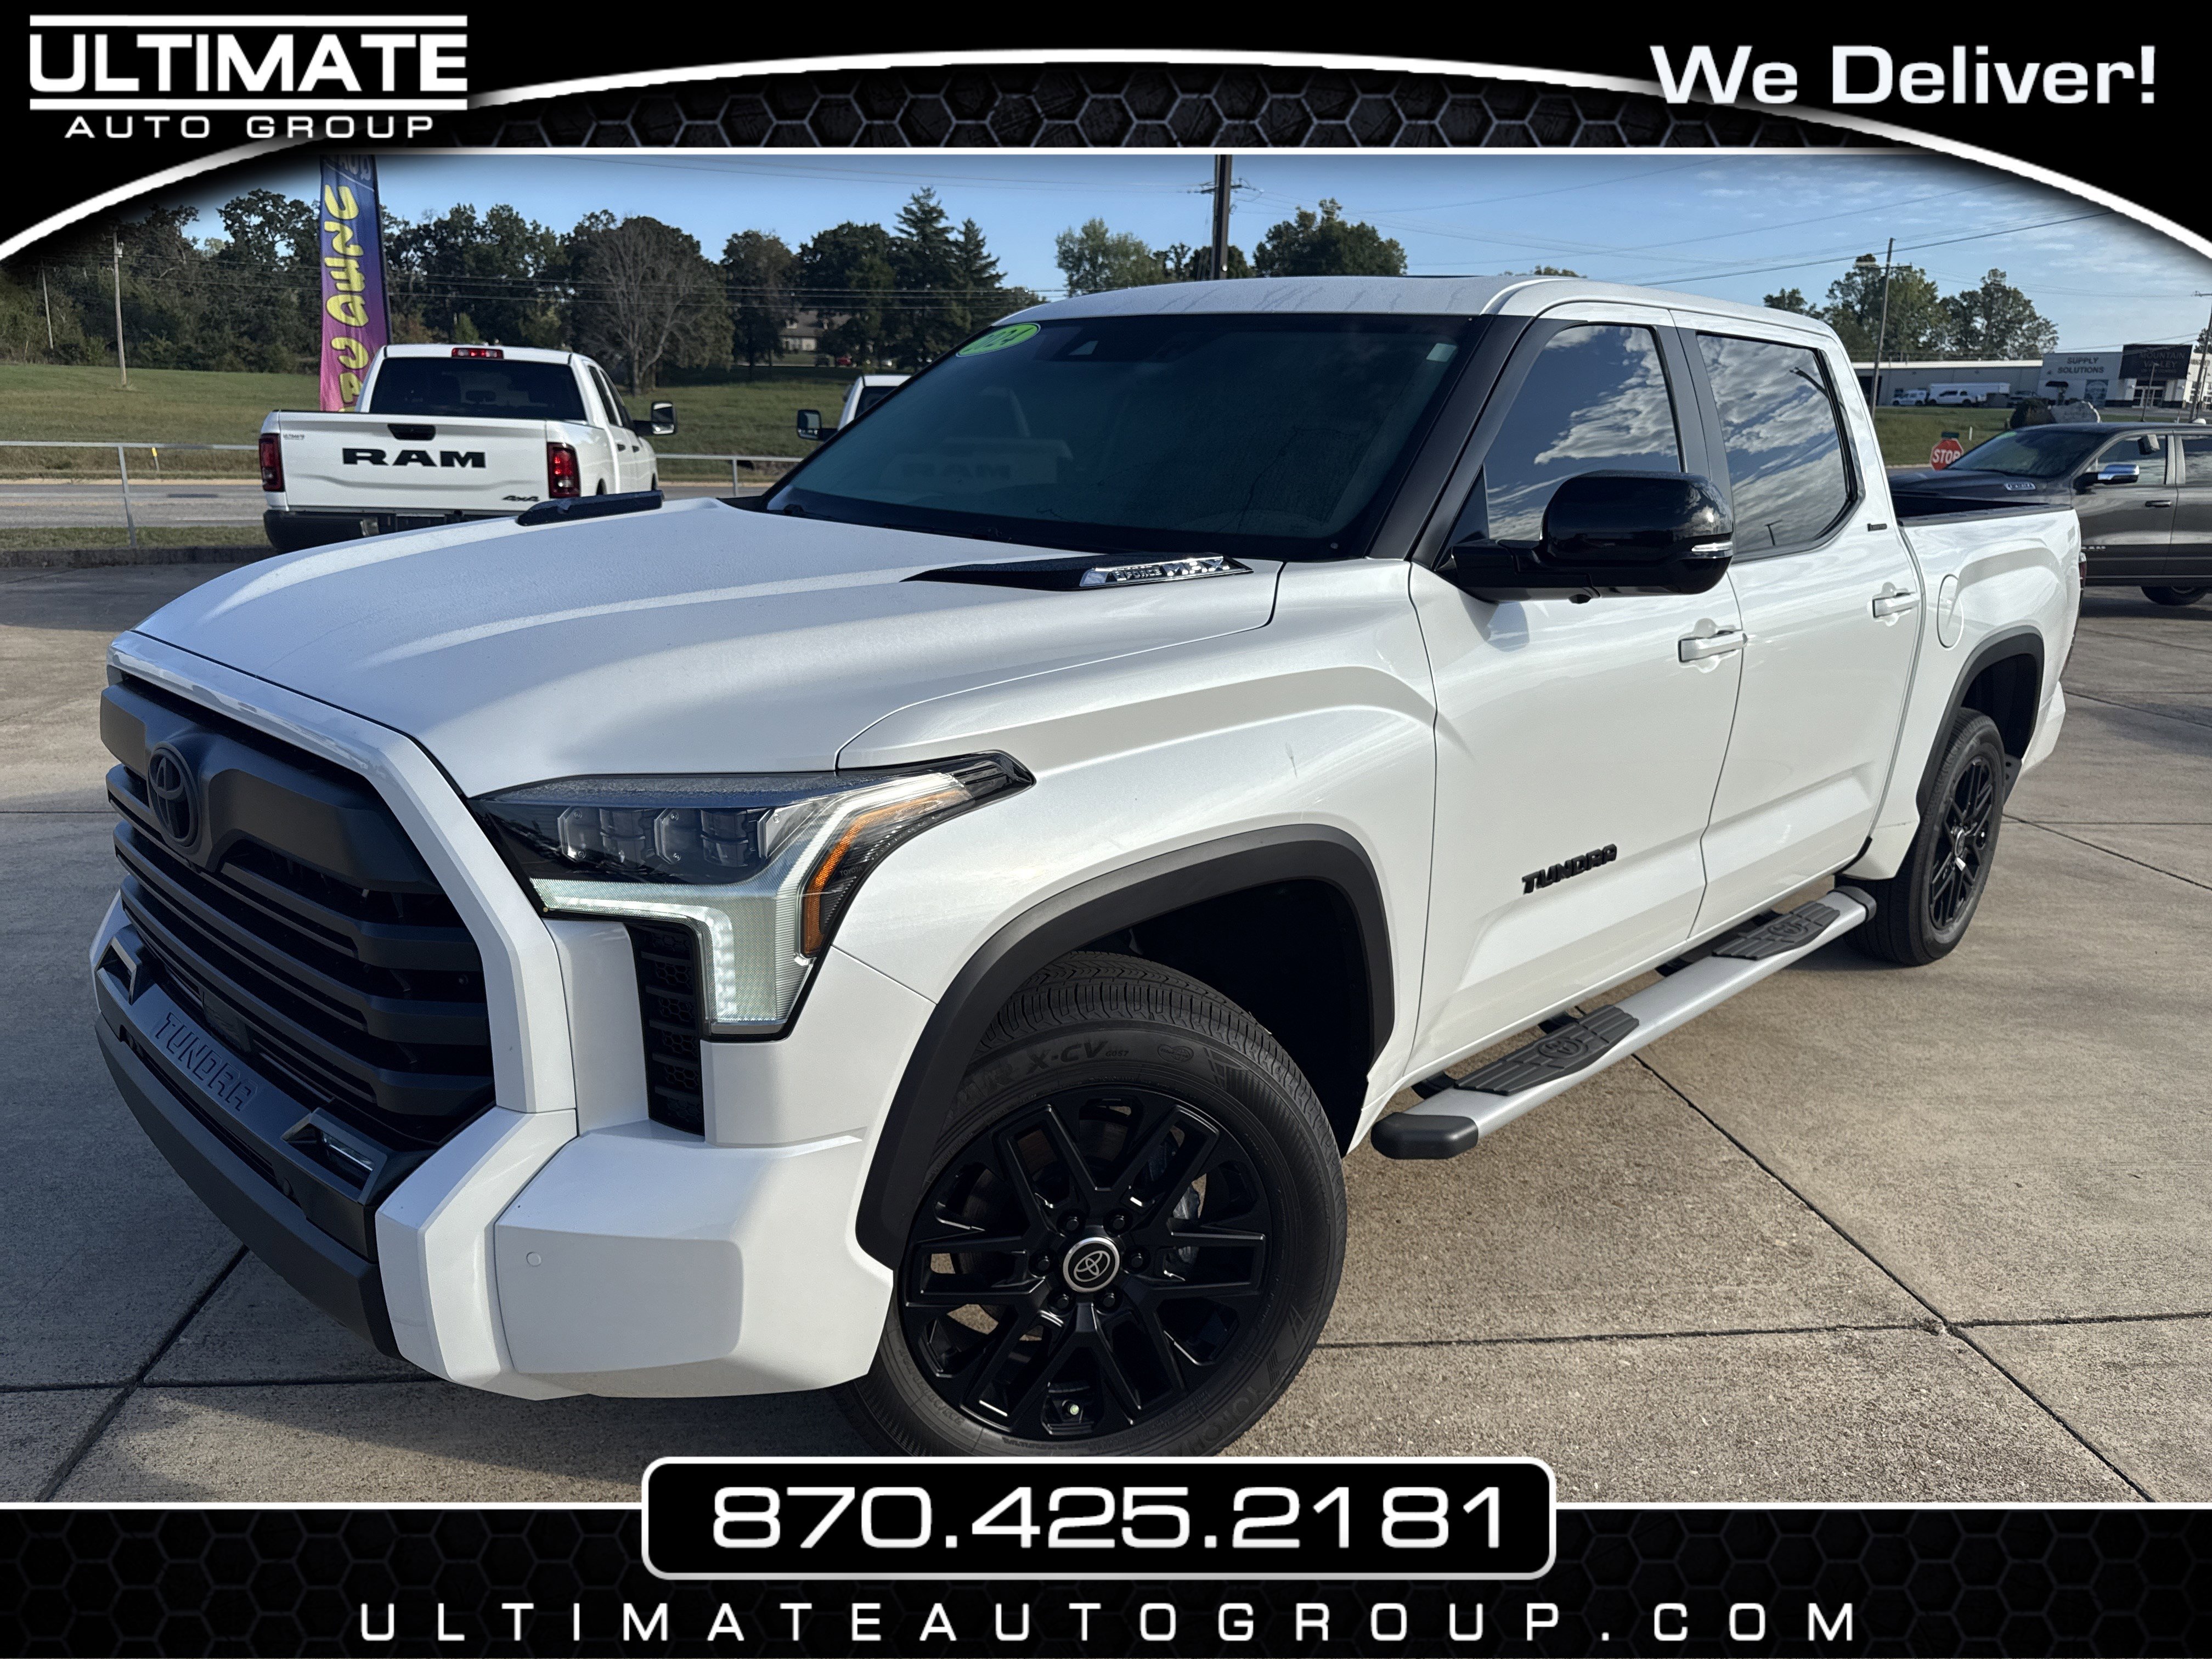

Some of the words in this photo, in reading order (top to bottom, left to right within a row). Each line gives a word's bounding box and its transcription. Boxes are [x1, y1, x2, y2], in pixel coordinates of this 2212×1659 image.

[2067, 356, 2100, 365] SUPPLY
[2139, 351, 2186, 360] MOUNTAIN
[2057, 365, 2104, 374] SOLUTIONS
[343, 448, 486, 469] RAM
[1933, 449, 1961, 465] STOP
[839, 866, 864, 877] TOYOTA
[1521, 843, 1617, 895] TUNDRA
[154, 1012, 258, 1112] TUNDRA
[1026, 1040, 1109, 1075] X-CV
[1105, 1049, 1129, 1058] G057
